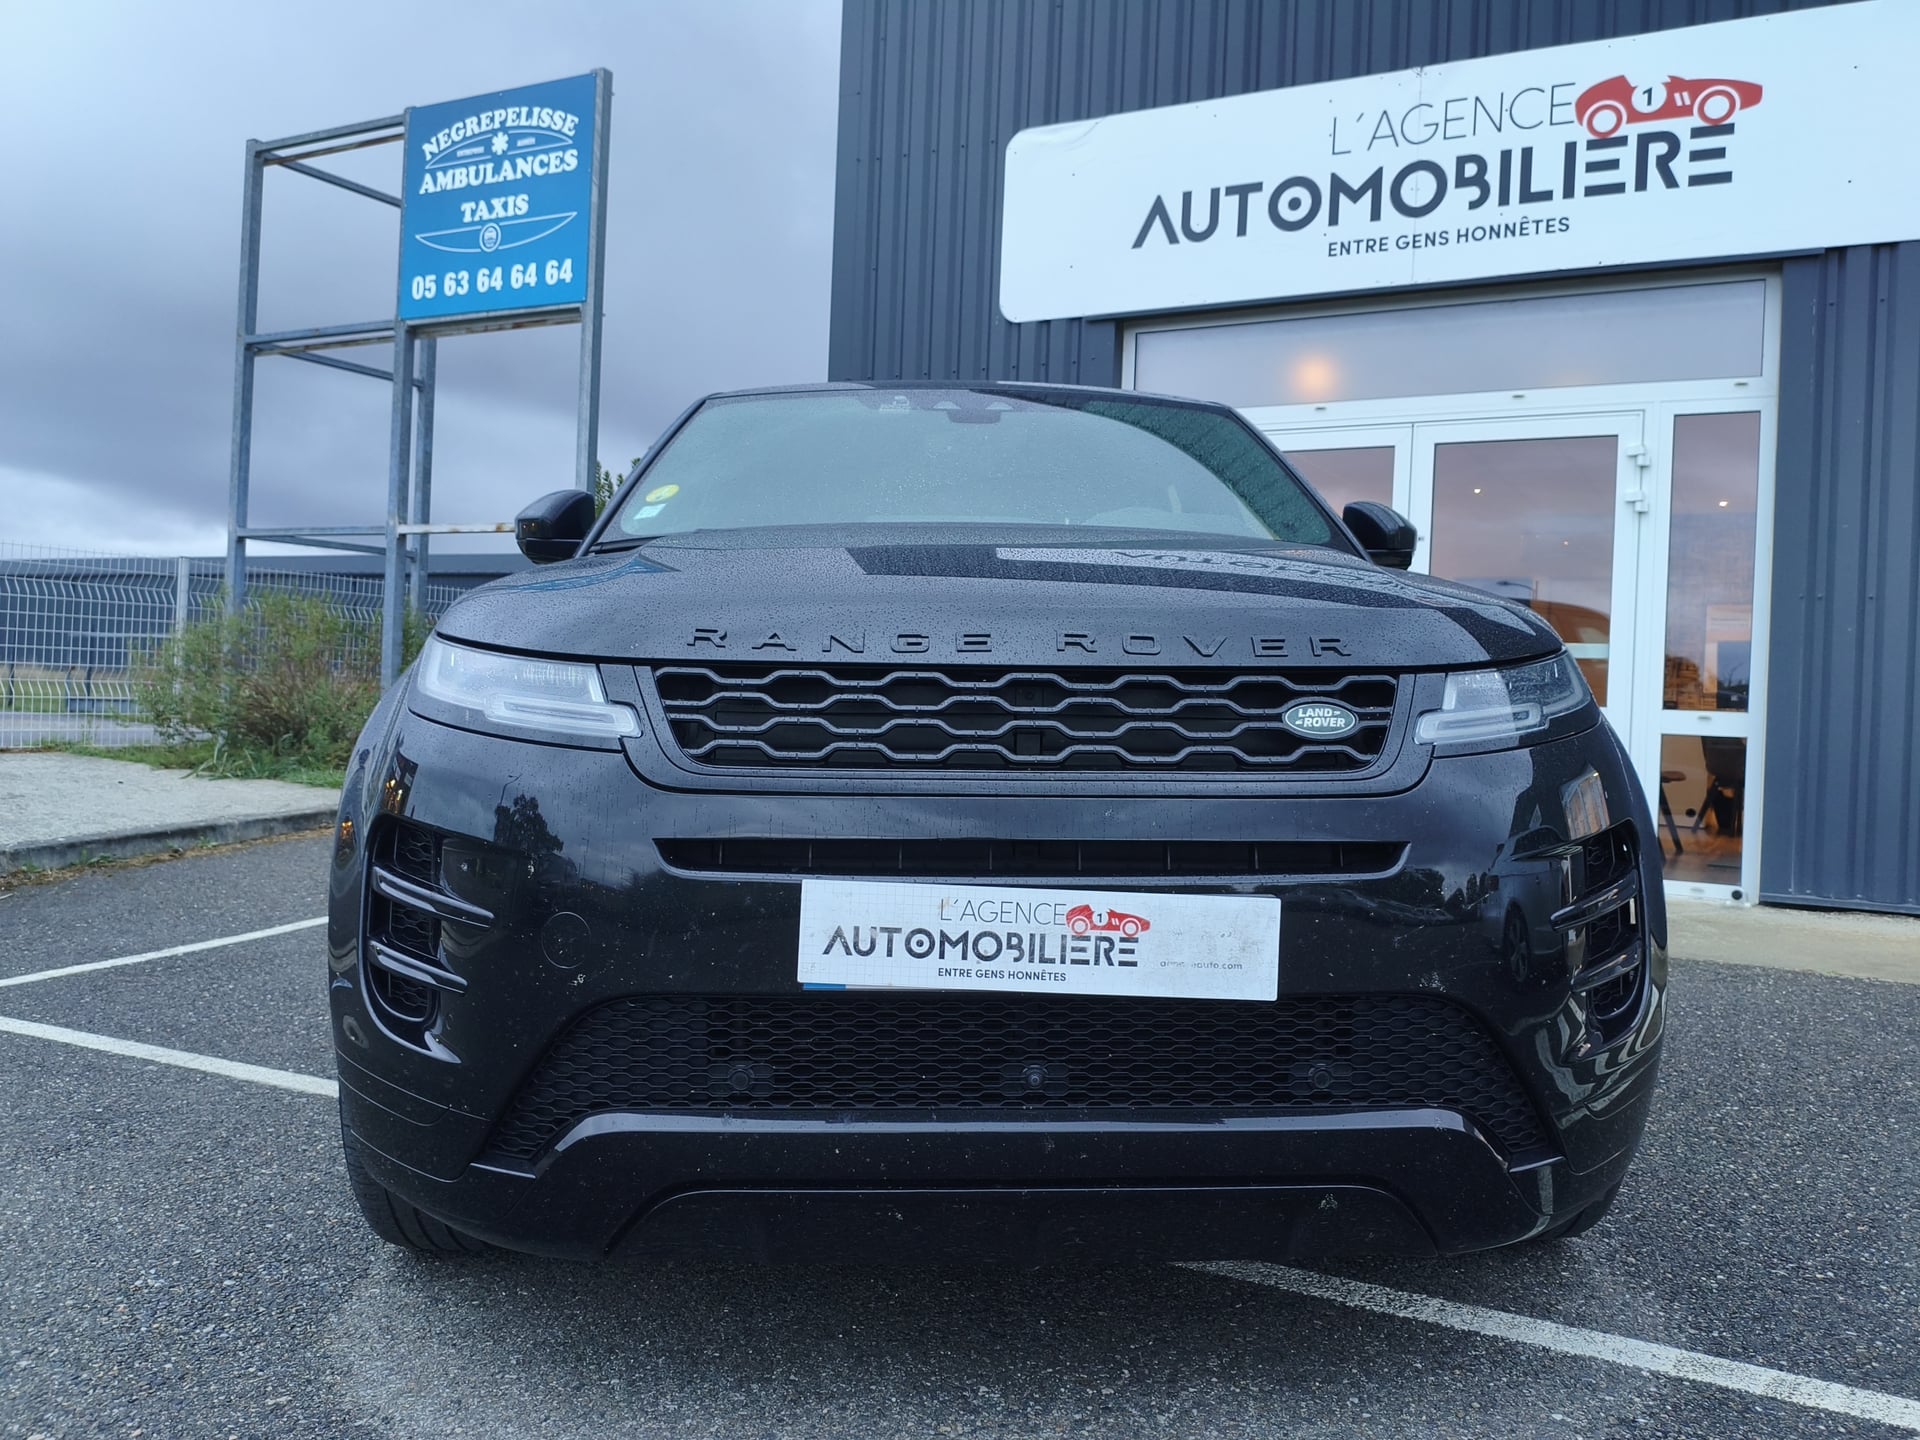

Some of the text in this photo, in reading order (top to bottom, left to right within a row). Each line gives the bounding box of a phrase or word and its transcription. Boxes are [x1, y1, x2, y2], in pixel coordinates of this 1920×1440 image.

[422, 106, 579, 161] NEGREPELISSE
[1331, 82, 1577, 156] L'AGENCE
[419, 148, 579, 194] AMBULANCES
[461, 194, 529, 223] TAXIS
[1327, 216, 1571, 258] ENTRE GENS HONNÊTES
[411, 258, 573, 300] 05 63 64 64 64
[687, 628, 1352, 658] RANGE ROVER
[1298, 708, 1333, 718] LAND
[1303, 717, 1346, 727] ROVER
[940, 898, 1067, 926] L'AGENCE
[938, 967, 1067, 982] ENTRE GENS HONNÊTES
